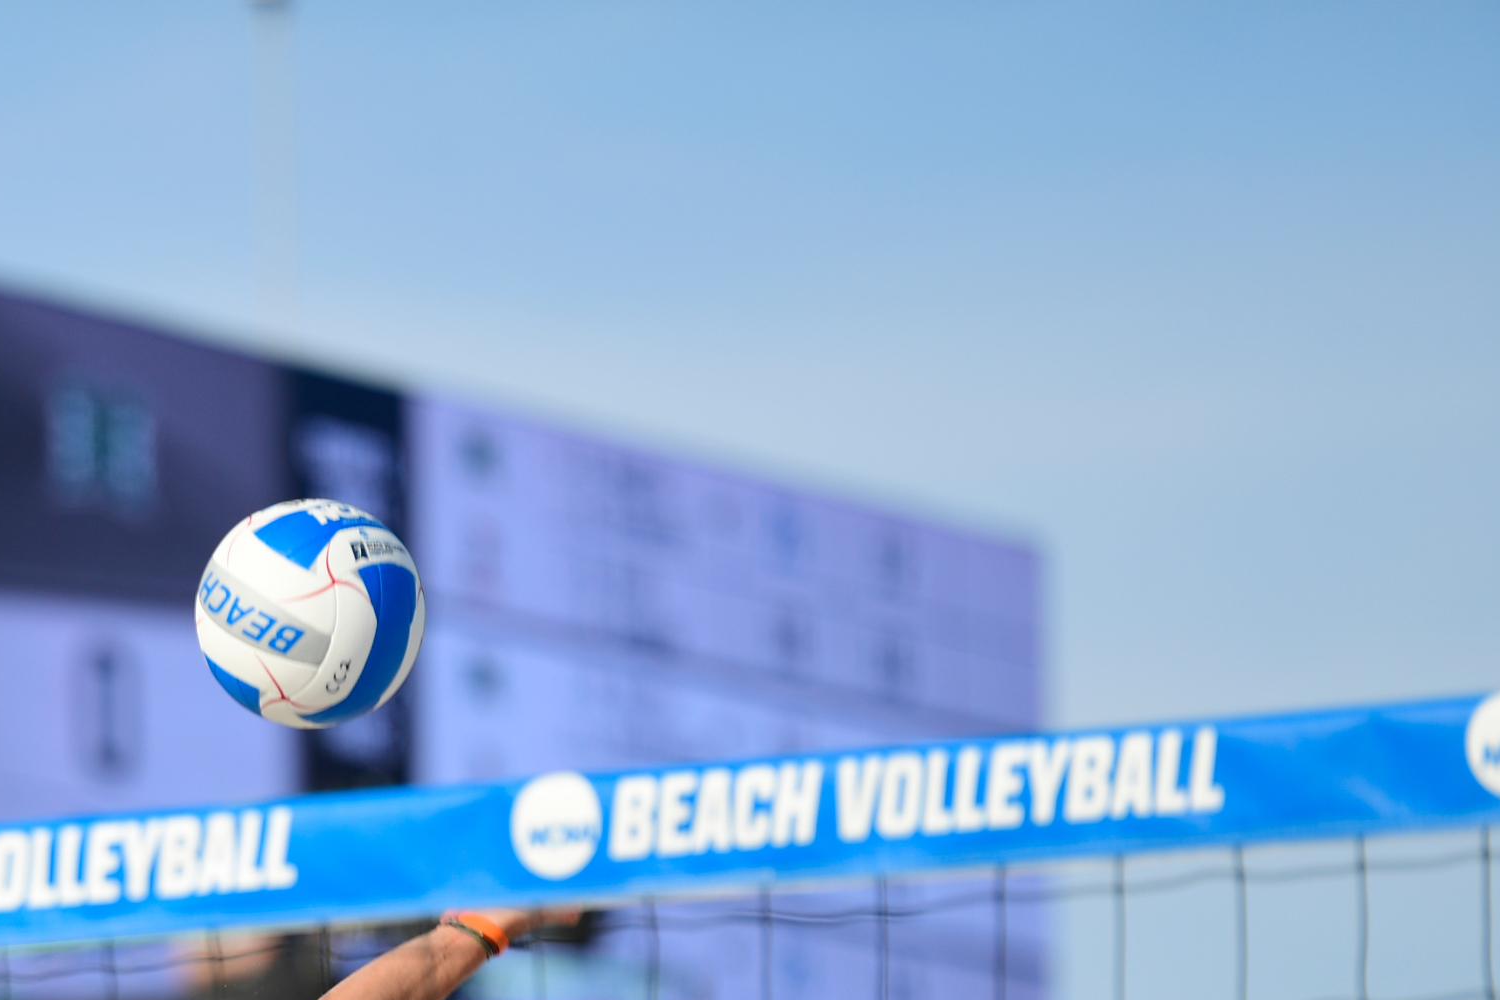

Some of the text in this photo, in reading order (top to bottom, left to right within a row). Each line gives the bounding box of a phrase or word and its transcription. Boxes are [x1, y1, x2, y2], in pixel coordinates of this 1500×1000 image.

[199, 571, 306, 655] BEACH
[607, 759, 824, 863] BEACH
[835, 725, 1225, 844] VOLLEYBALL
